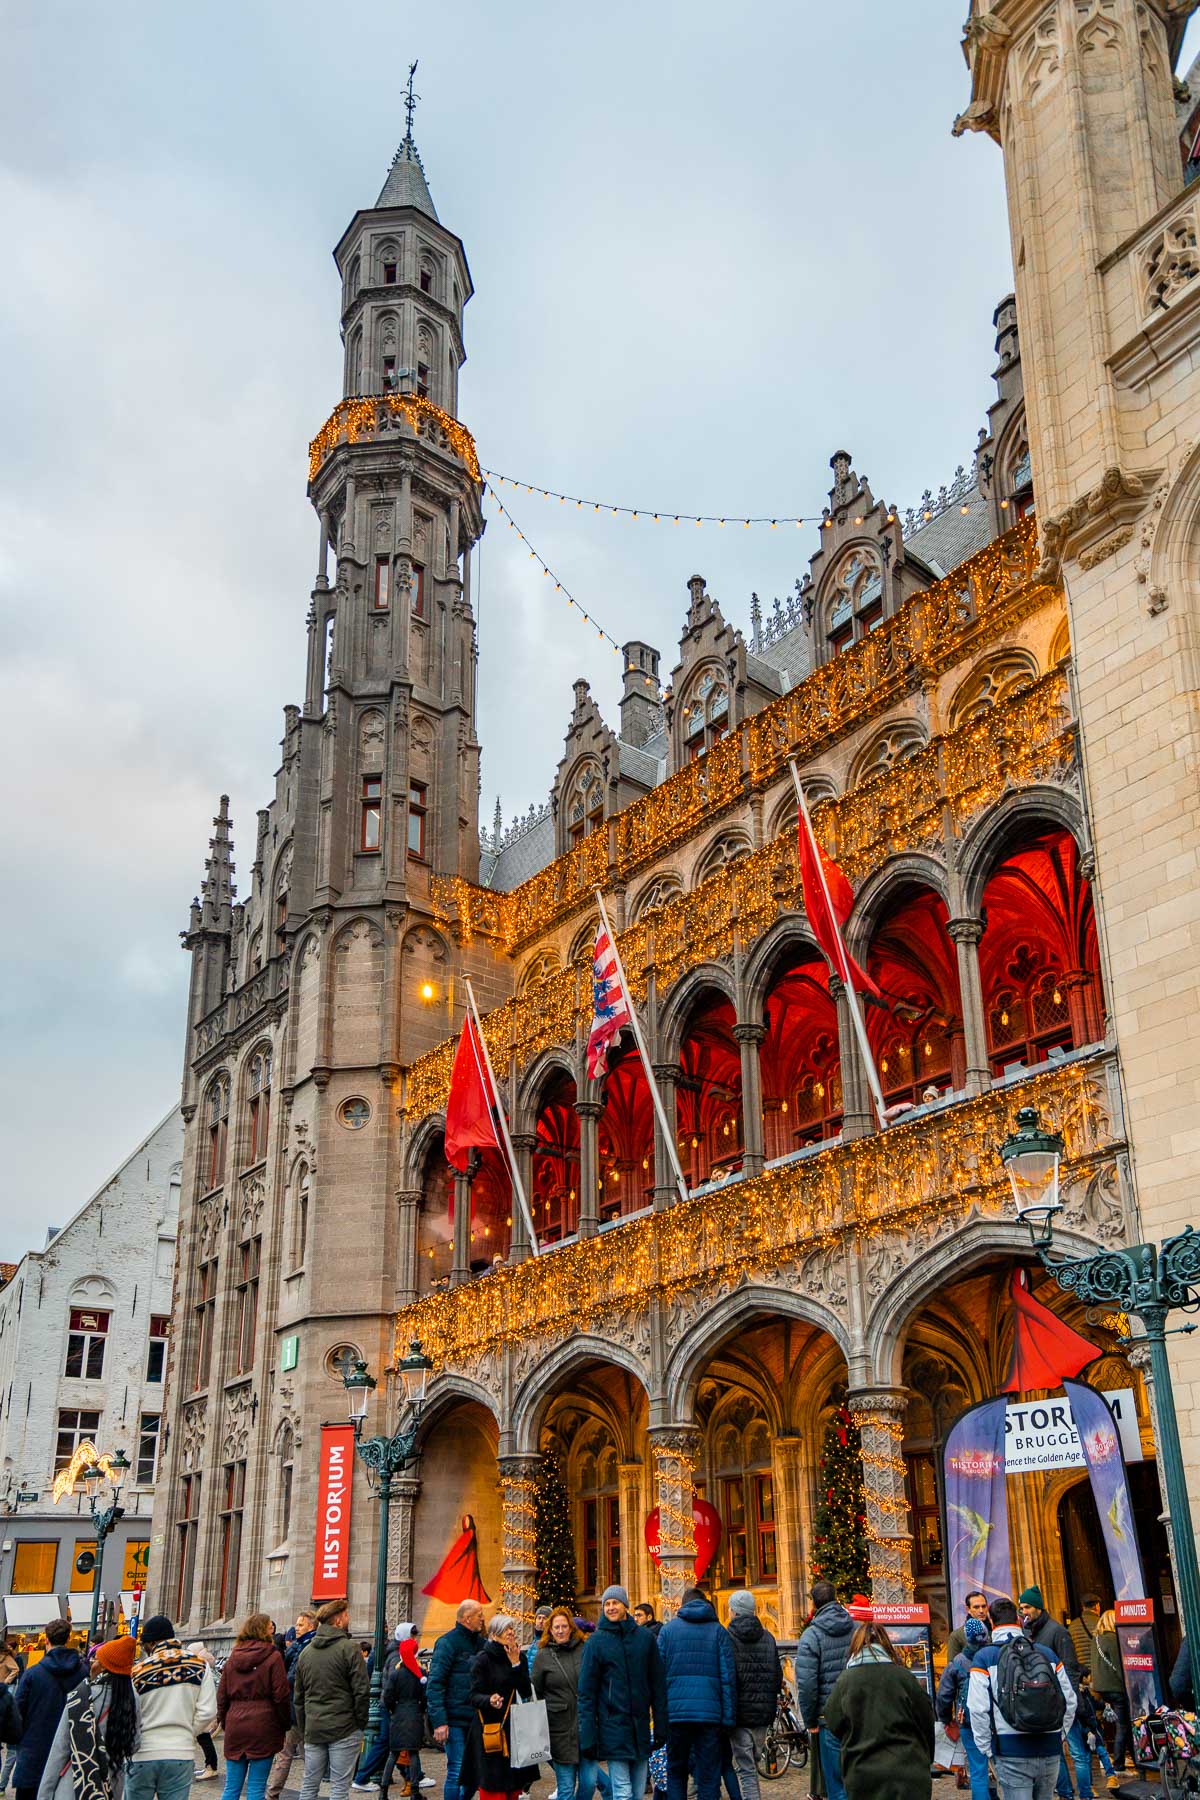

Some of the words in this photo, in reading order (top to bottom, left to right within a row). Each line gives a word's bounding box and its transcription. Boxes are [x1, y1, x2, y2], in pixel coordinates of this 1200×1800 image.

[1016, 1432, 1079, 1450] BRUGGE
[952, 1461, 999, 1469] HISTORIM
[1005, 1458, 1023, 1467] ience
[1024, 1456, 1036, 1465] the
[1037, 1453, 1064, 1463] Golden
[1065, 1451, 1081, 1463] Age
[323, 1446, 346, 1579] HISTORIUM
[1124, 1604, 1146, 1616] MINUTES
